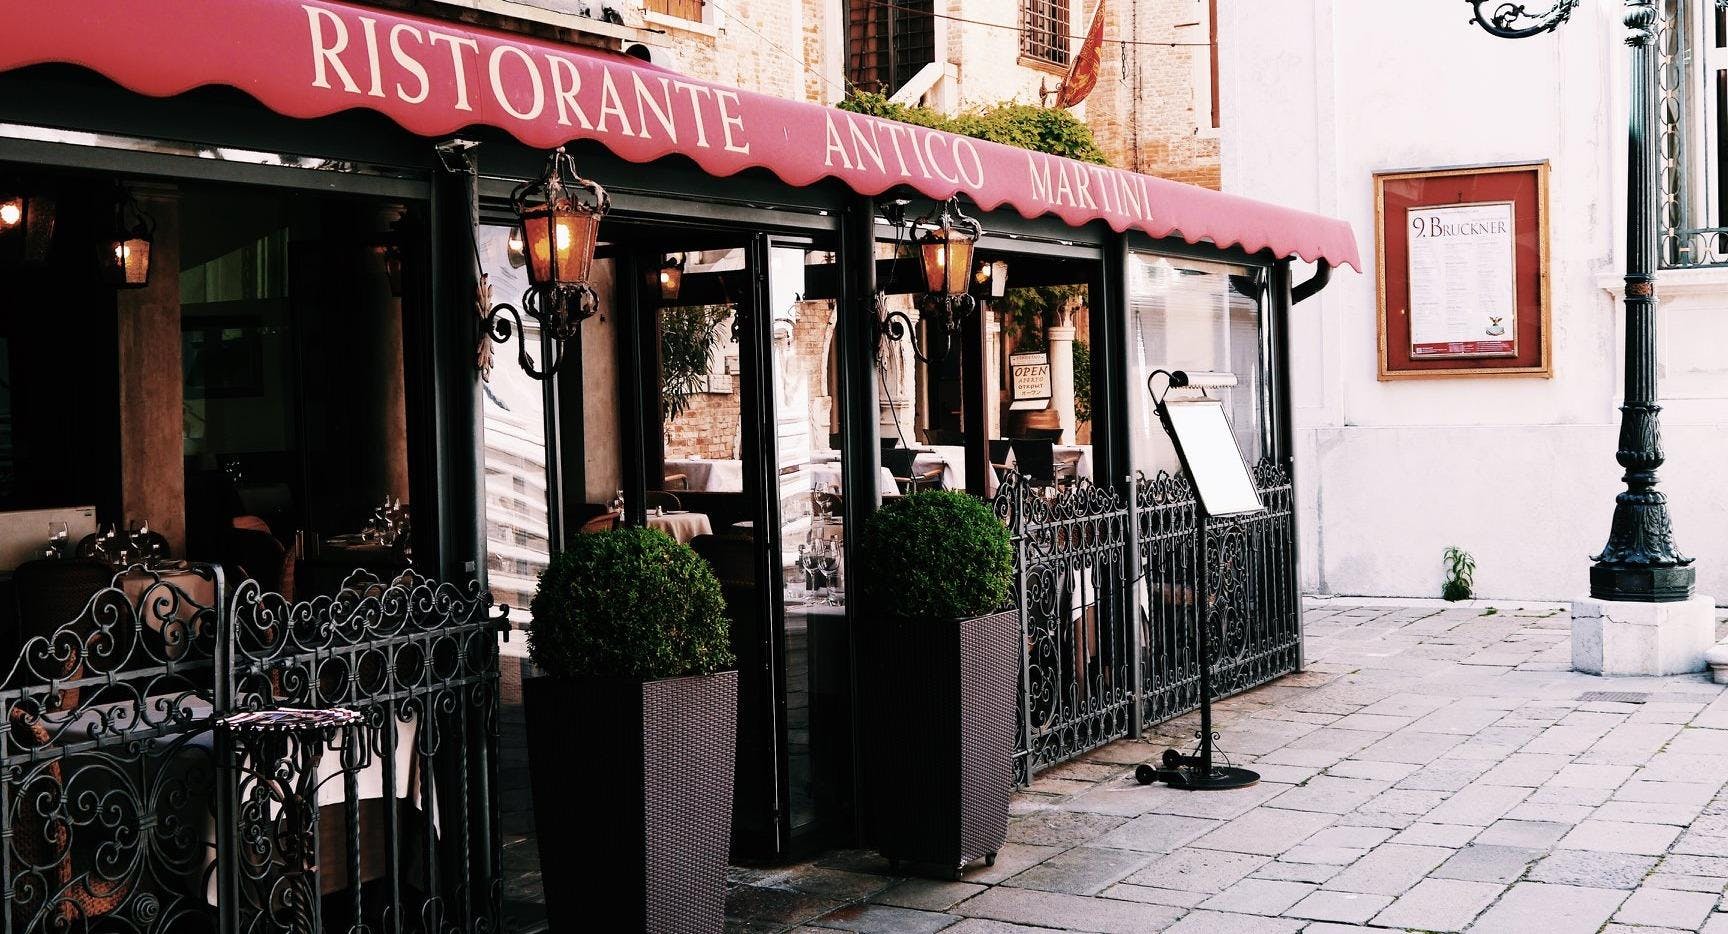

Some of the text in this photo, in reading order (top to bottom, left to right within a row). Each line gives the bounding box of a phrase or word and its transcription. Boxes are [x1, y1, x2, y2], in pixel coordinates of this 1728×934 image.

[302, 5, 1154, 221] RISTORANTE ANTICO MARTINI
[1412, 217, 1426, 238] 9.
[1014, 366, 1048, 377] OPEN
